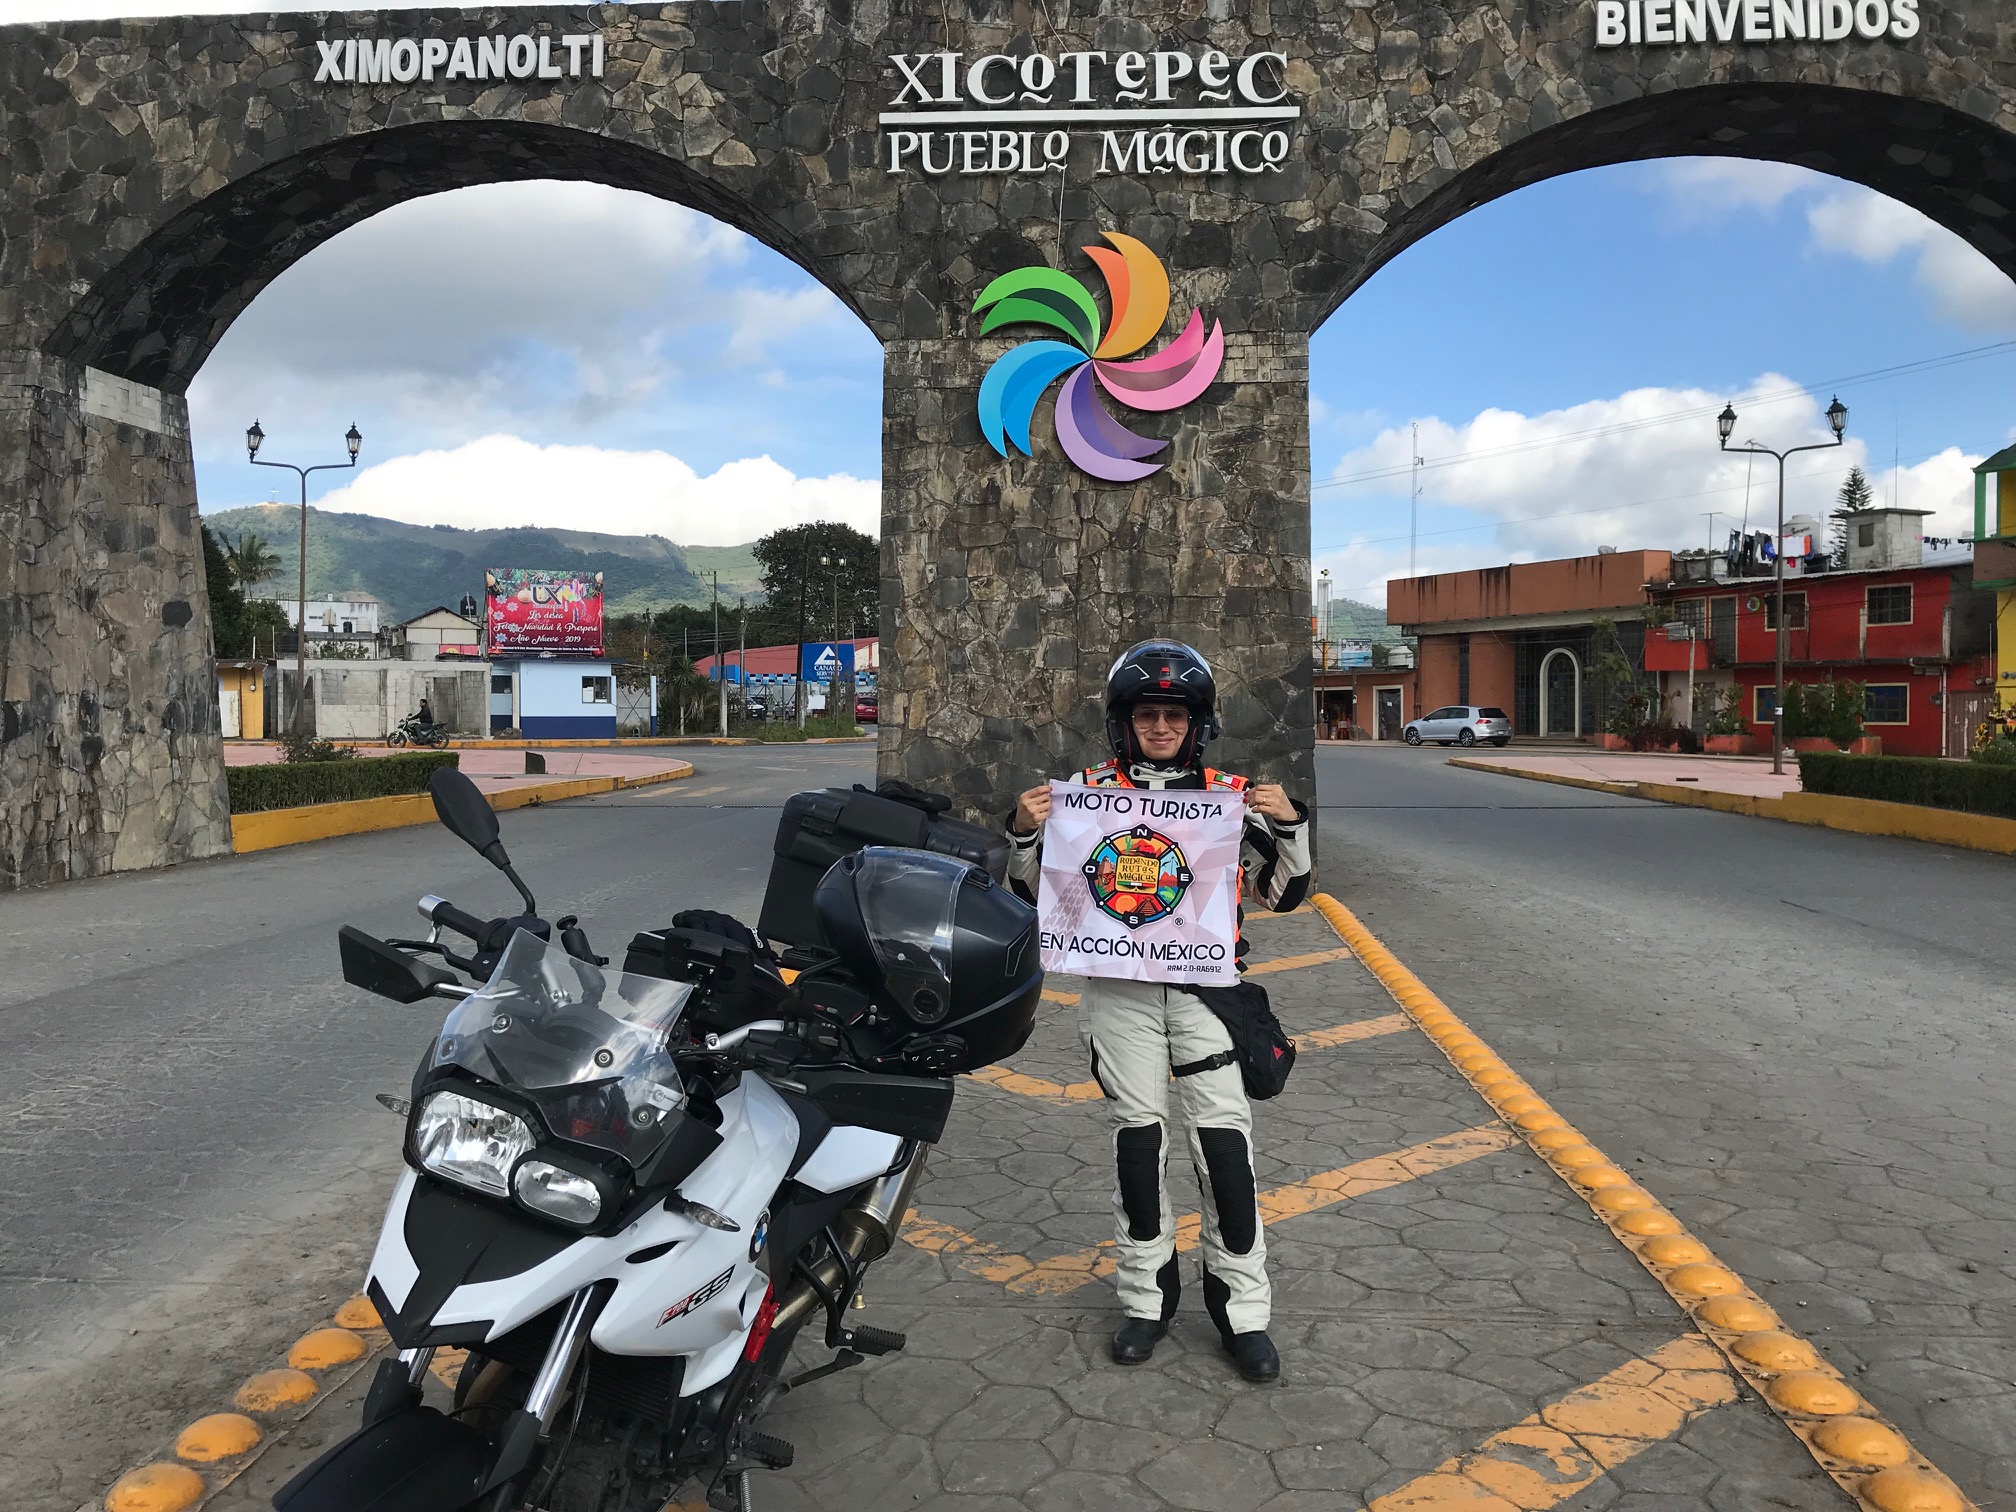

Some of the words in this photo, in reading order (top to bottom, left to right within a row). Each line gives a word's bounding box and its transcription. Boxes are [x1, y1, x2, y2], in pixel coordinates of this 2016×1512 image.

[1595, 0, 1919, 46] BIENVENIDOS
[314, 34, 604, 84] XIMOPANOLTI
[518, 622, 554, 633] Navidad
[510, 634, 530, 645] Año
[531, 634, 559, 645] Nuevo
[1065, 792, 1133, 814] MOTO
[1139, 797, 1223, 820] TURISTA
[1136, 828, 1148, 837] N
[1084, 865, 1096, 874] O
[1180, 873, 1190, 882] E
[1129, 916, 1139, 924] S
[1040, 931, 1065, 951] EN
[1068, 934, 1145, 960] ACCIÓN
[1149, 939, 1226, 961] MÉXICO
